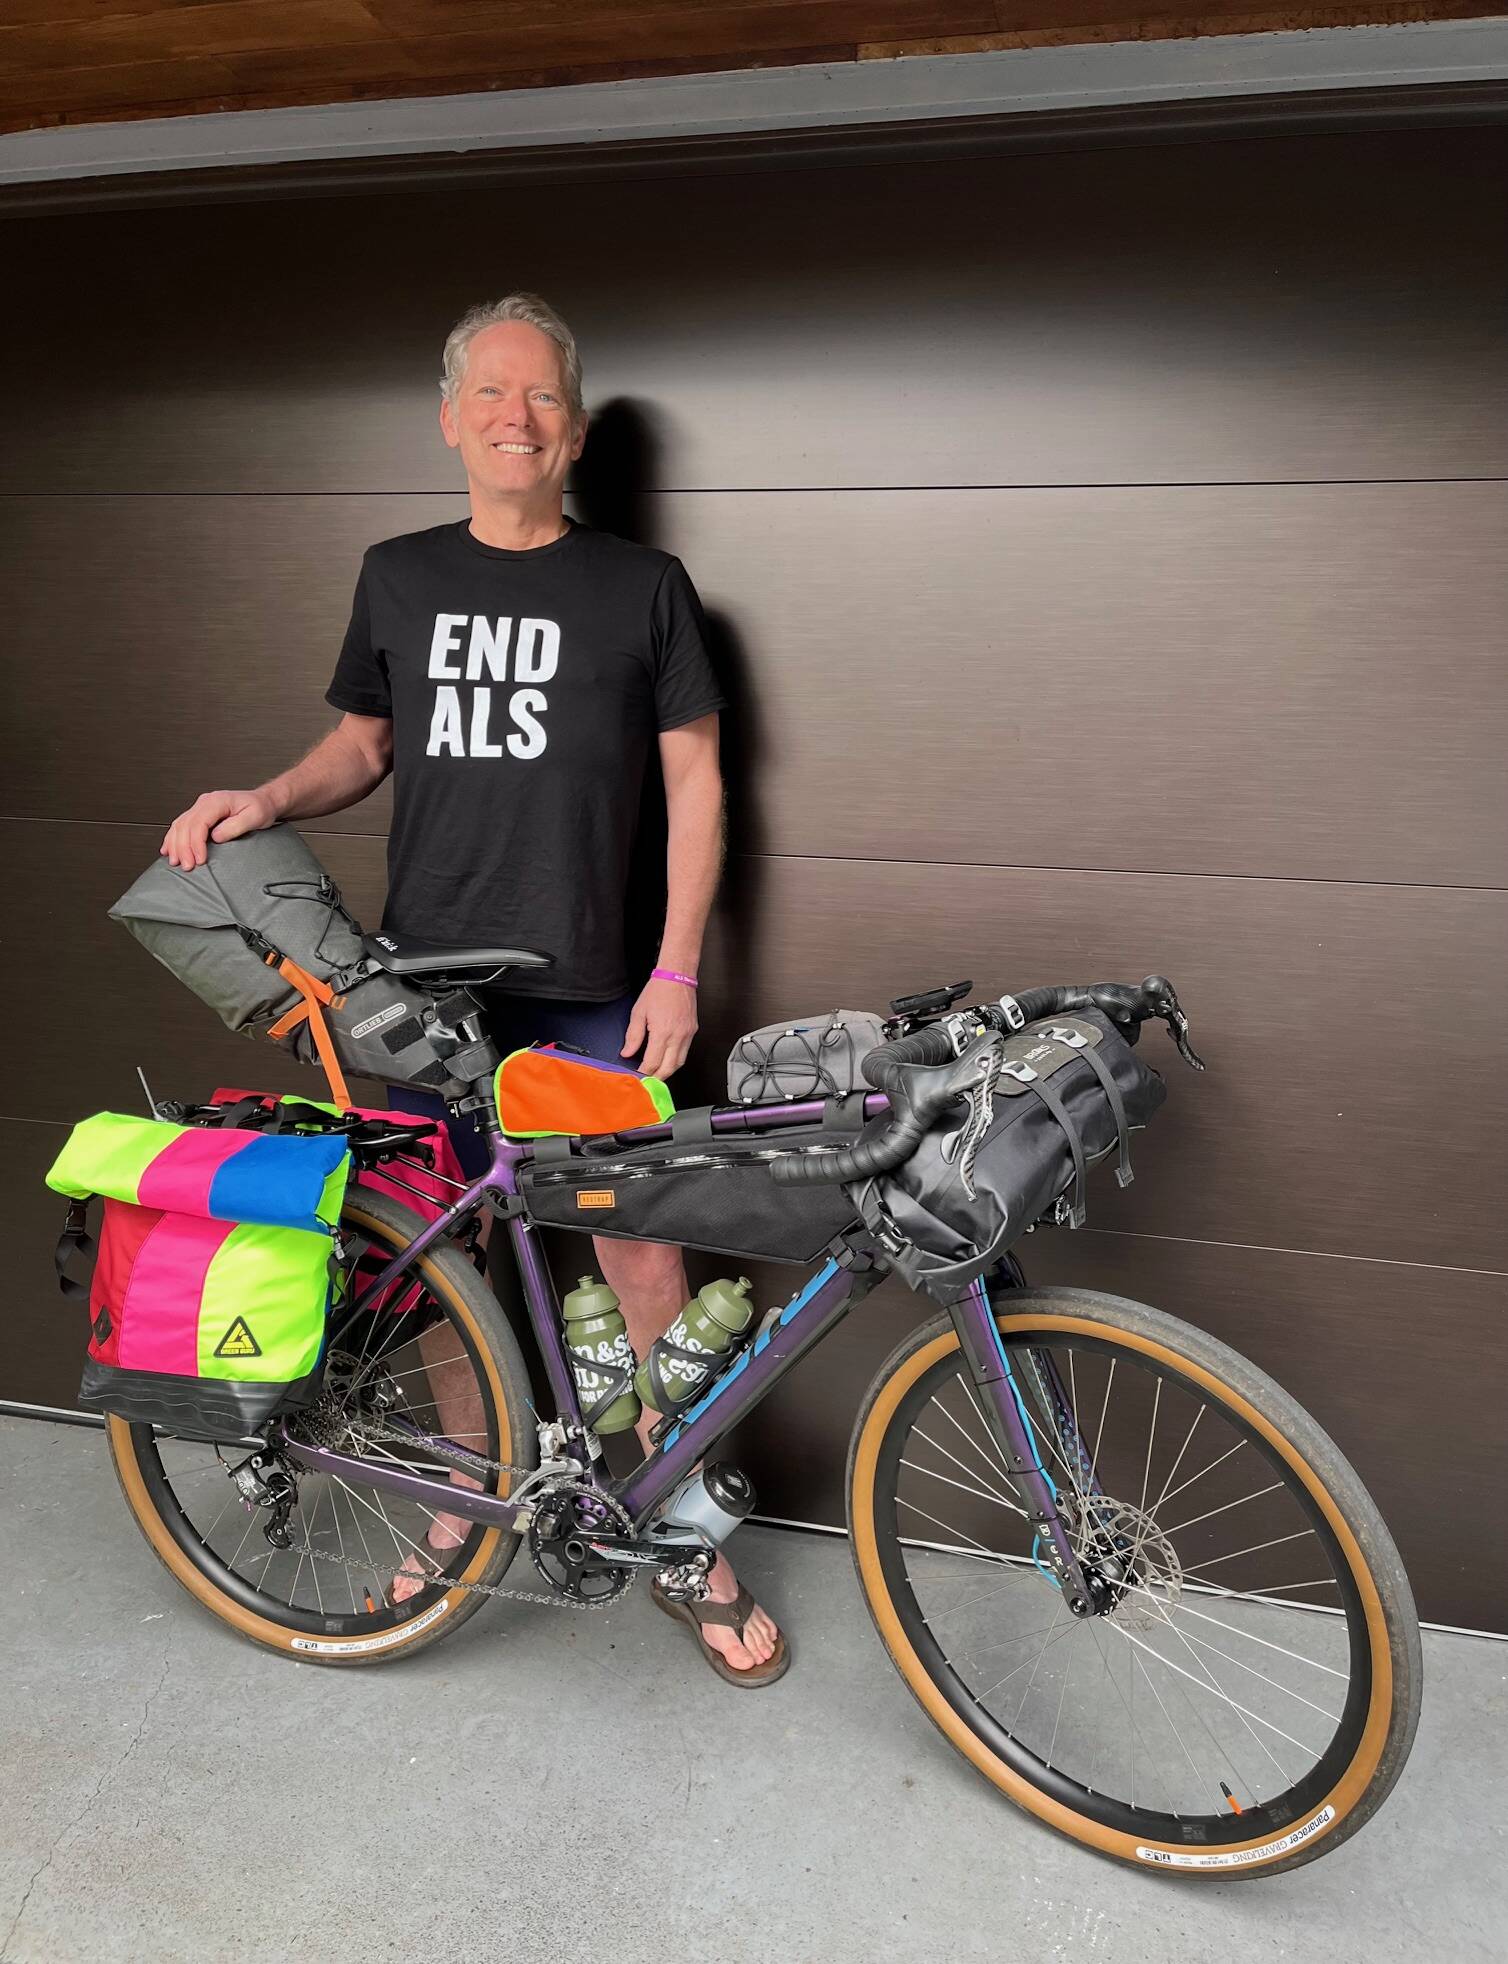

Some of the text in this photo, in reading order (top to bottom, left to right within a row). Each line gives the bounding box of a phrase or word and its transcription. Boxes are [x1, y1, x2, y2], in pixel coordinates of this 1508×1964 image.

[428, 613, 561, 683] END
[426, 686, 548, 760] ALS
[354, 1017, 382, 1036] ORTLIEB
[1289, 1809, 1330, 1844] Panaracer
[1232, 1840, 1288, 1863] GRAVELKING
